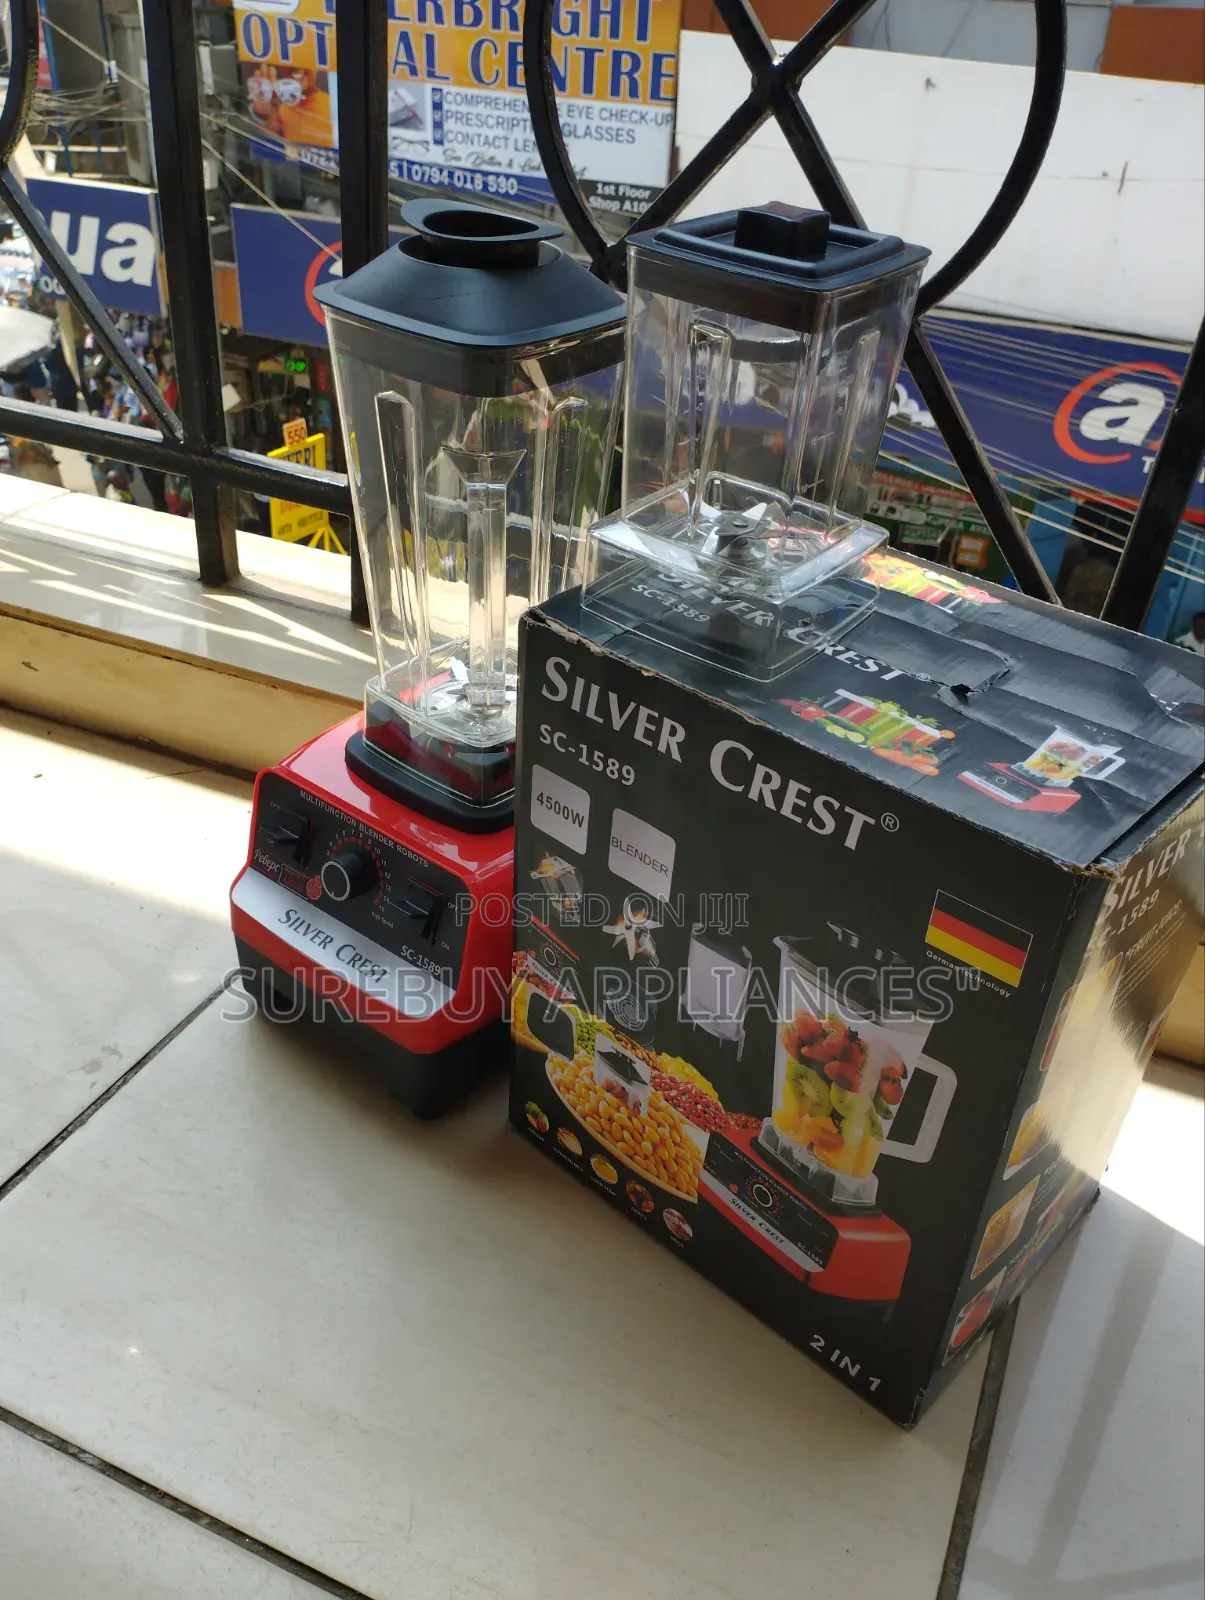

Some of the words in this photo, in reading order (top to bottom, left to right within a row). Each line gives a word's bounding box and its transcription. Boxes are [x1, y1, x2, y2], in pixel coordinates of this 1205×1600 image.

[242, 13, 450, 80] OPTAL
[470, 38, 677, 103] CENTRE
[562, 123, 636, 144] GLASSES
[567, 104, 596, 120] EYE
[599, 109, 674, 127] CHECK-UP
[445, 130, 510, 150] CONTACT
[411, 165, 449, 185] 0794
[596, 183, 615, 195] 1st
[619, 184, 651, 199] Floor
[588, 196, 621, 212] Shop
[623, 199, 653, 213] A10
[541, 656, 687, 764] SILVER
[539, 723, 636, 788] SC-1589
[299, 789, 357, 827] MULTIFUNCTION
[359, 822, 394, 849] BLENDER
[396, 844, 429, 869] ROBOTS
[536, 791, 586, 830] 4500W
[610, 835, 670, 879] BLENDER
[277, 908, 335, 950] SILVER
[335, 943, 392, 984] CREST
[400, 944, 441, 977] SC-1589
[926, 950, 959, 973] German
[729, 1197, 757, 1222] SILVER
[759, 1221, 785, 1244] CREST
[809, 1334, 826, 1353] 2
[830, 1349, 861, 1378] IN
[868, 1375, 882, 1392] 1
